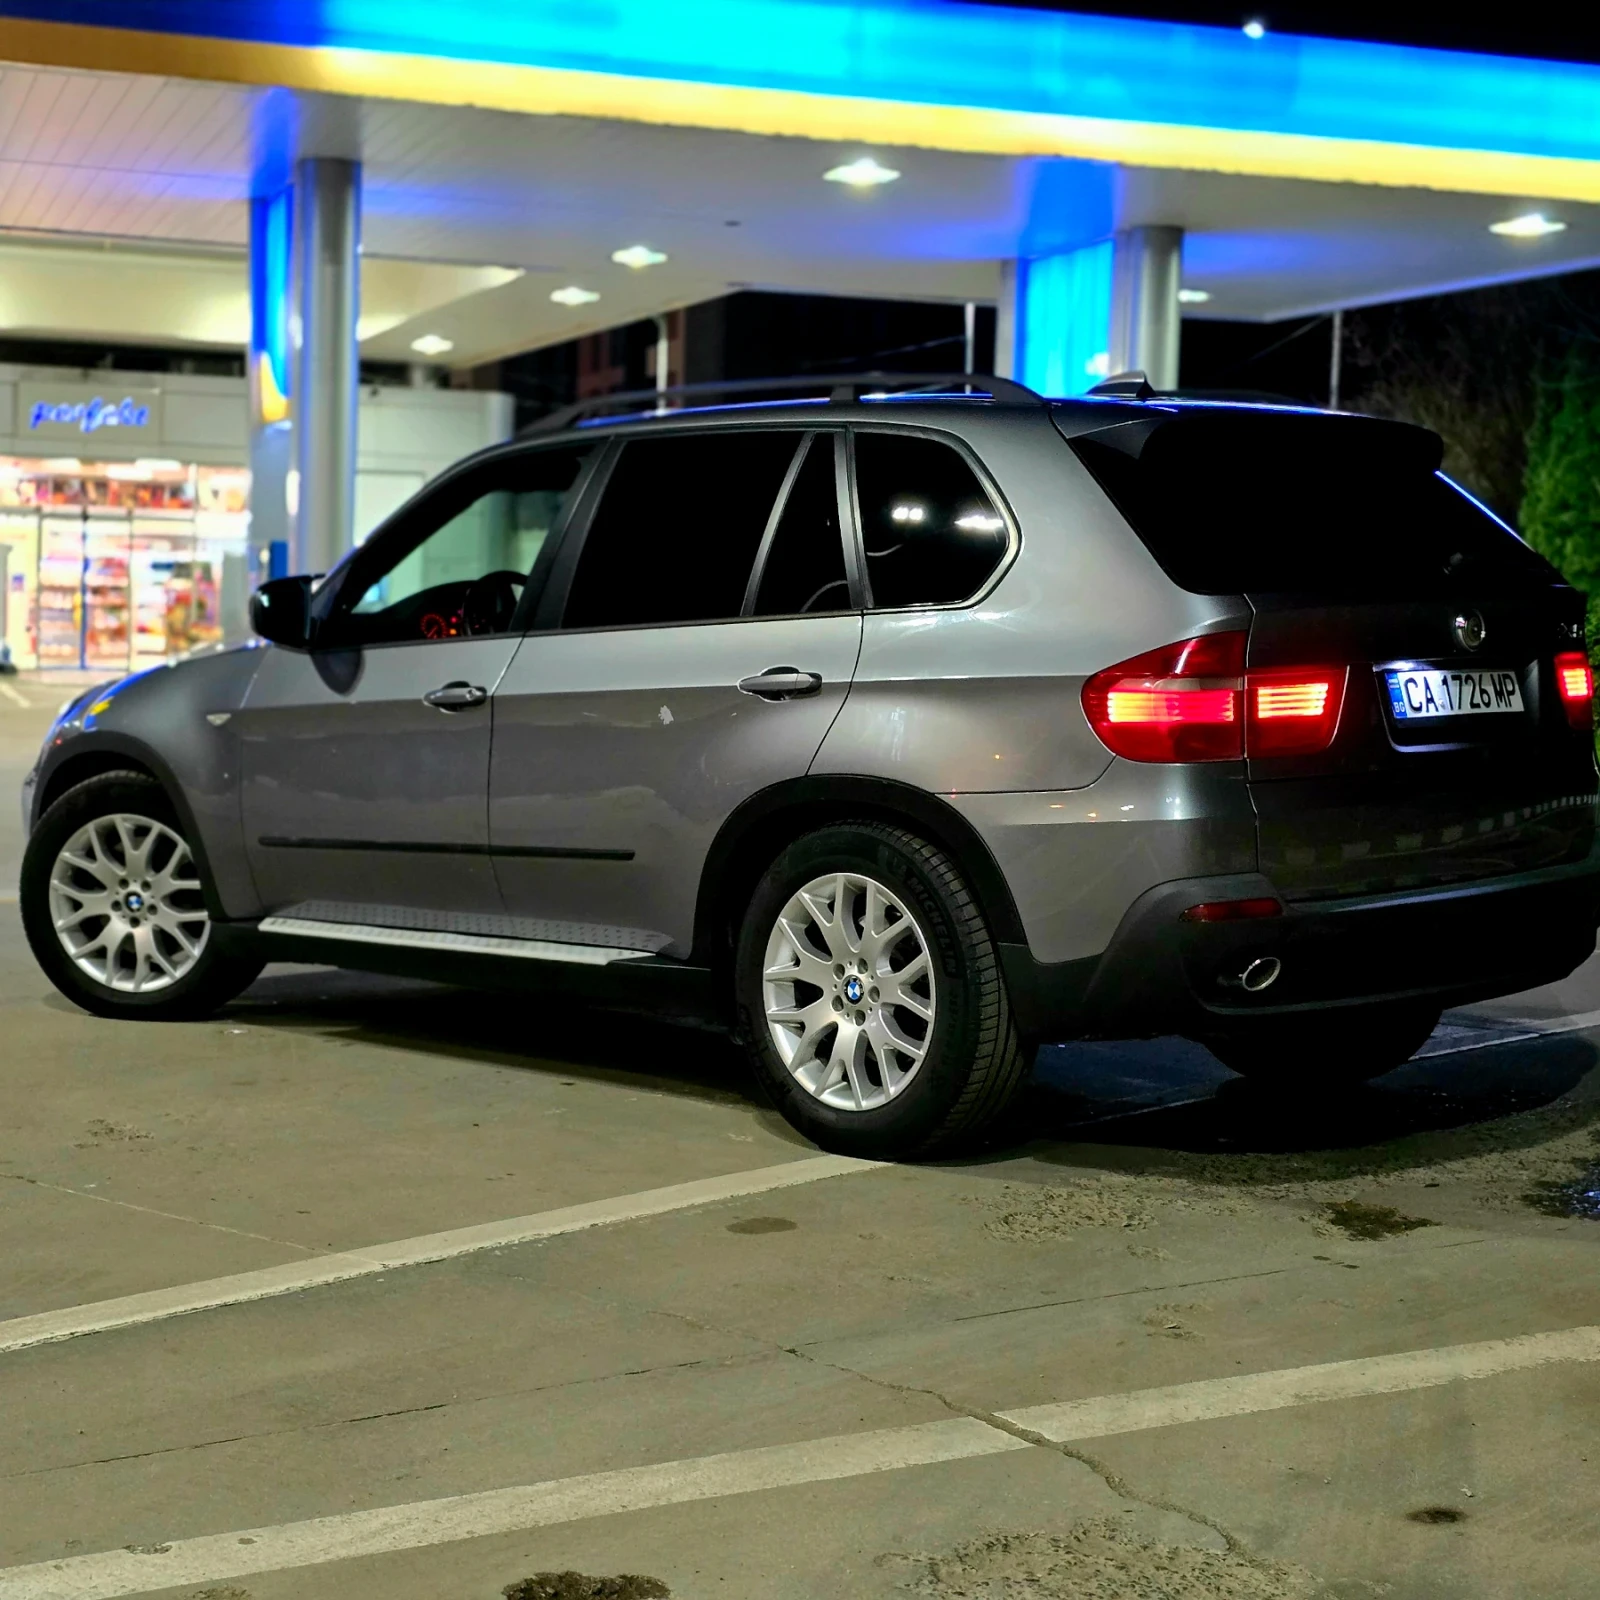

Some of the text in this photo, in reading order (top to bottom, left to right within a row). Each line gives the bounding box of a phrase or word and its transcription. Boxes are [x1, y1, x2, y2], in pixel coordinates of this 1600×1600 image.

[1393, 701, 1406, 713] BG
[1403, 672, 1516, 713] CA 1726 MP
[906, 874, 958, 974] MICHELIN
